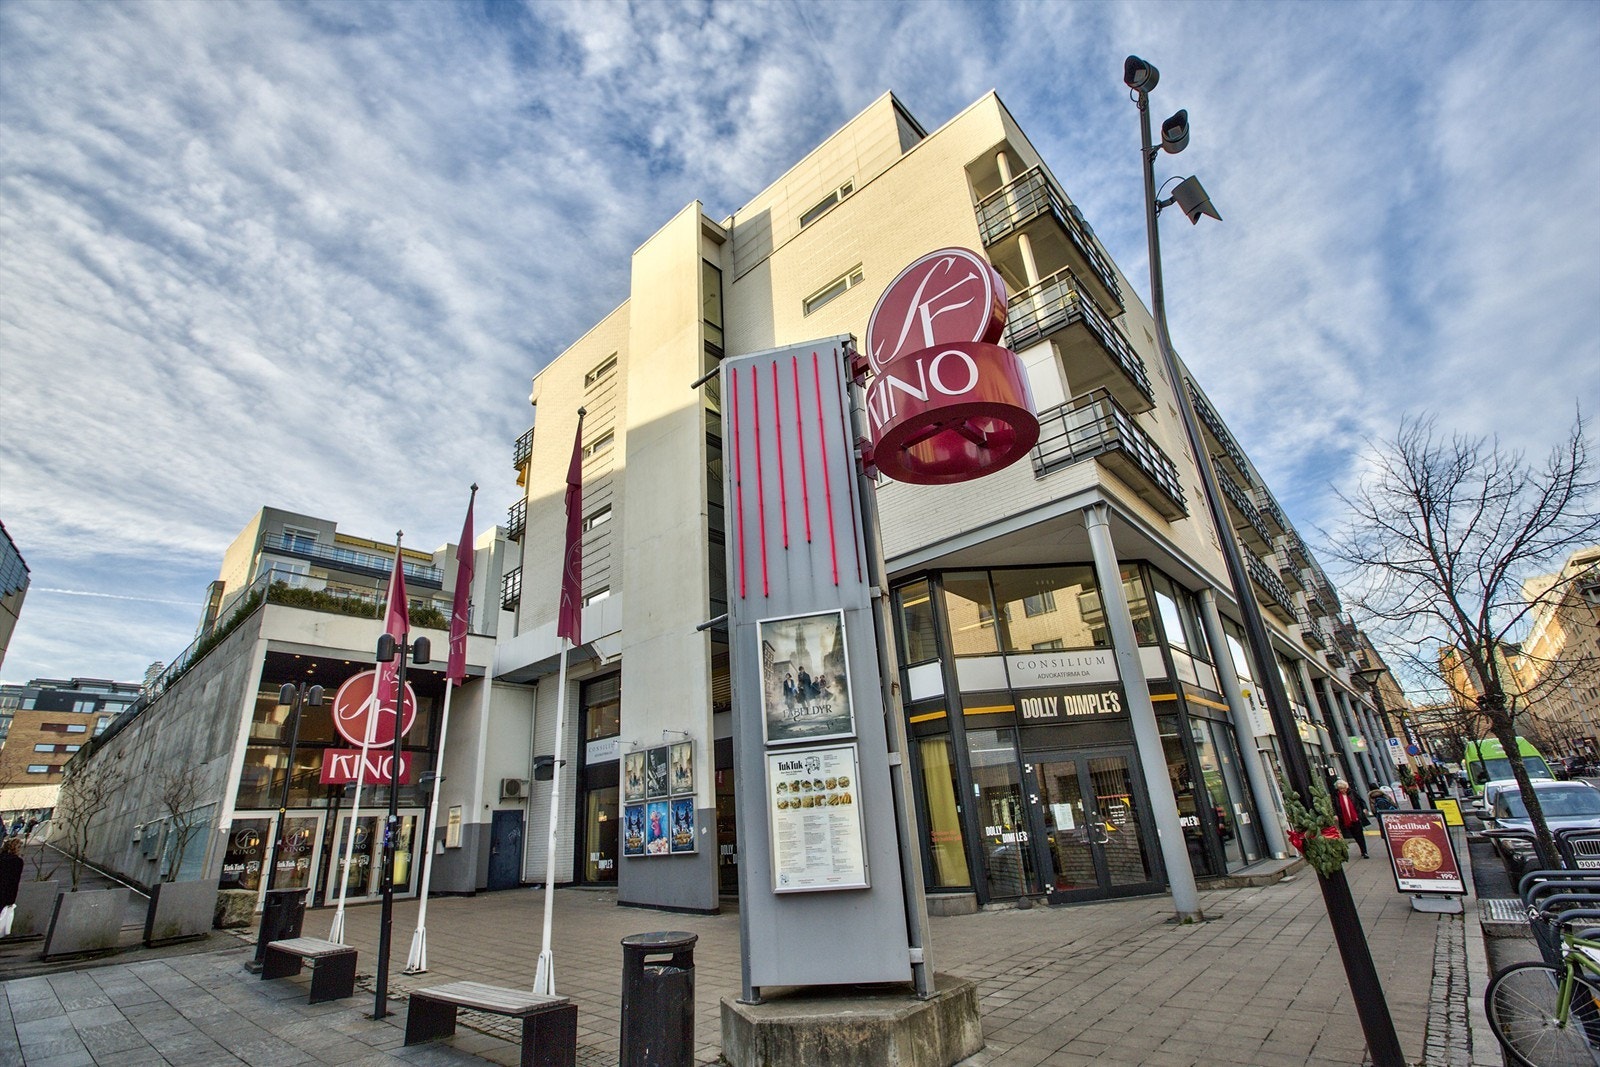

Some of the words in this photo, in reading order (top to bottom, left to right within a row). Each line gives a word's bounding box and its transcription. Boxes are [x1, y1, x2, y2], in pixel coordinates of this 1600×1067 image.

[1017, 656, 1106, 670] CONSILIUM
[1021, 697, 1058, 719] DOLLY
[1064, 690, 1121, 716] DIMPLE'S
[329, 753, 405, 779] KINO
[985, 825, 1002, 836] DOLLY
[1388, 822, 1430, 830] Juletilbud
[232, 848, 257, 856] KINO
